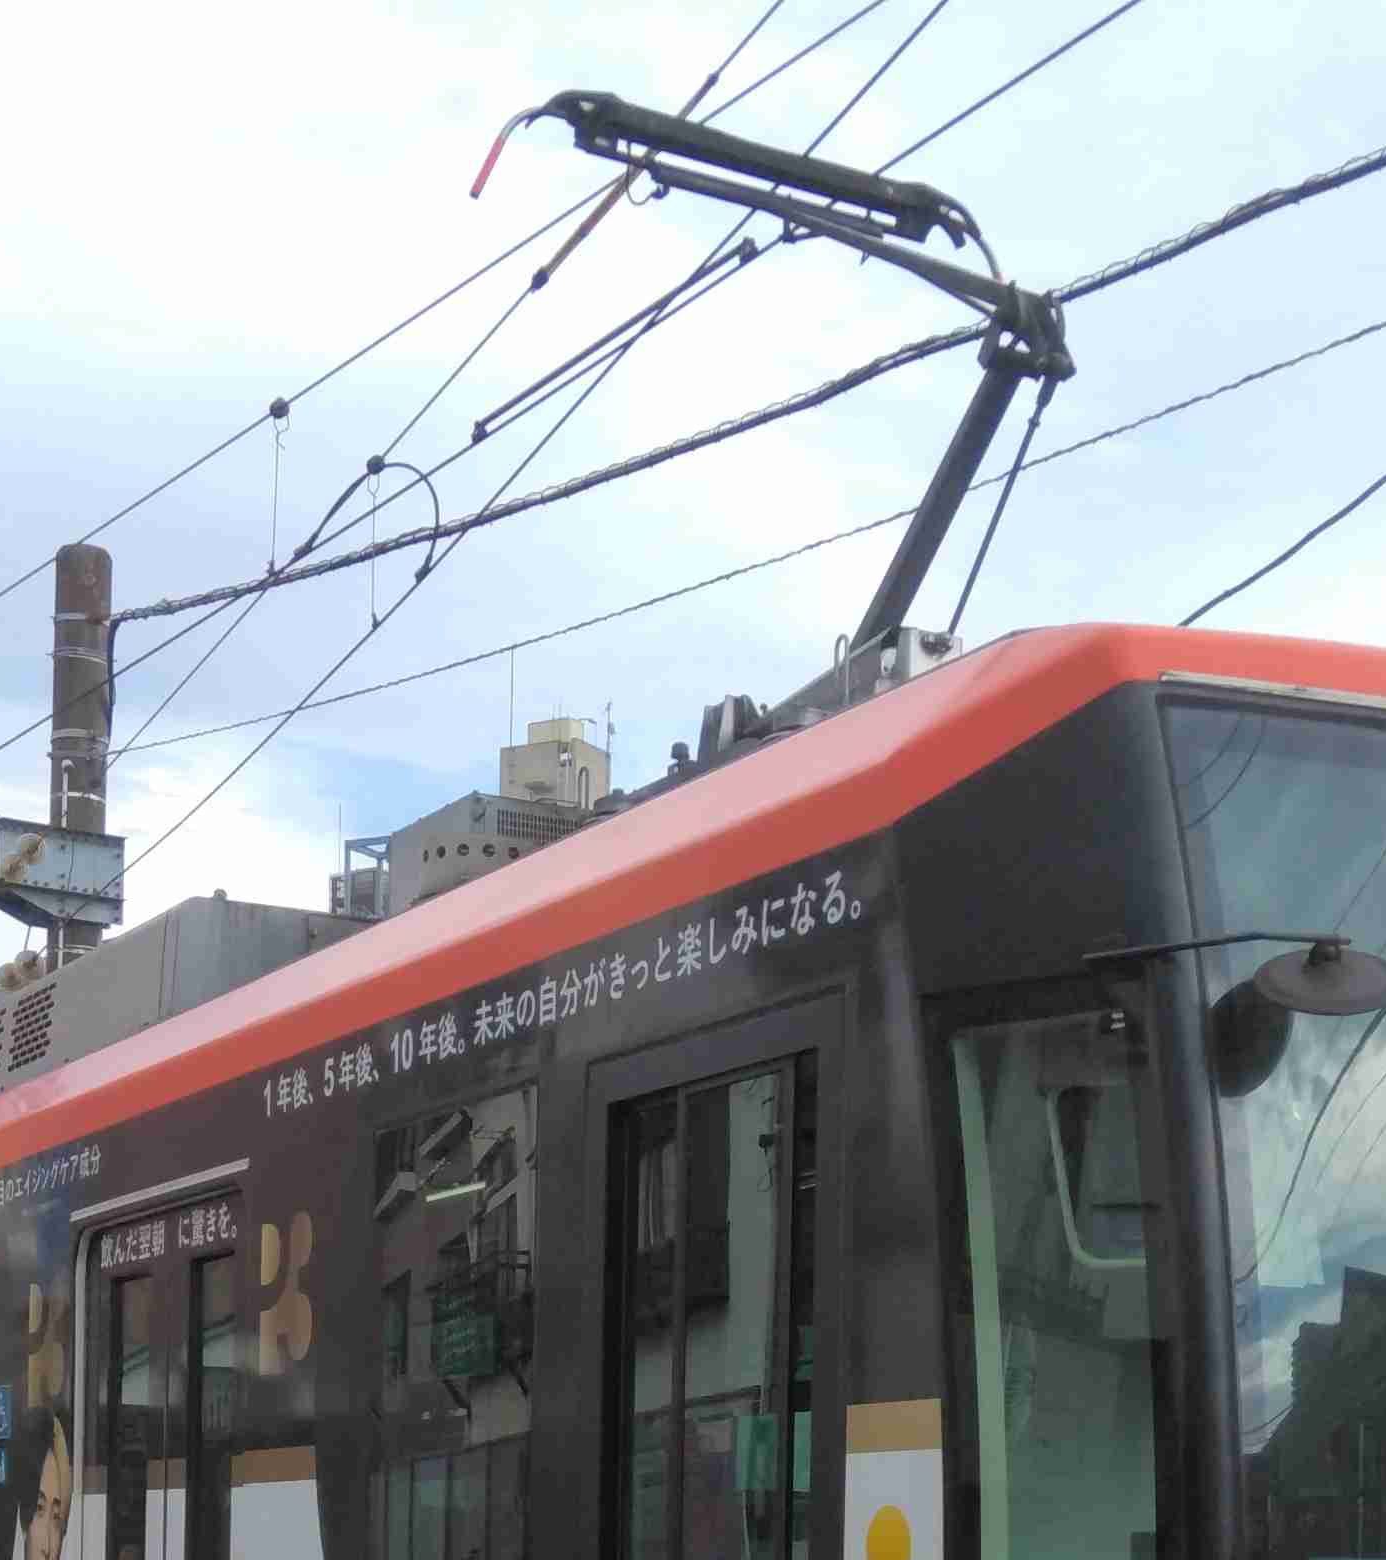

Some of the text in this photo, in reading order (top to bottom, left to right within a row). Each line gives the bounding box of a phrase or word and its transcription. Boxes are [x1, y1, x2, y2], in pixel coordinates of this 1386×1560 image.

[101, 1219, 165, 1269] 飲んだ翌朝
